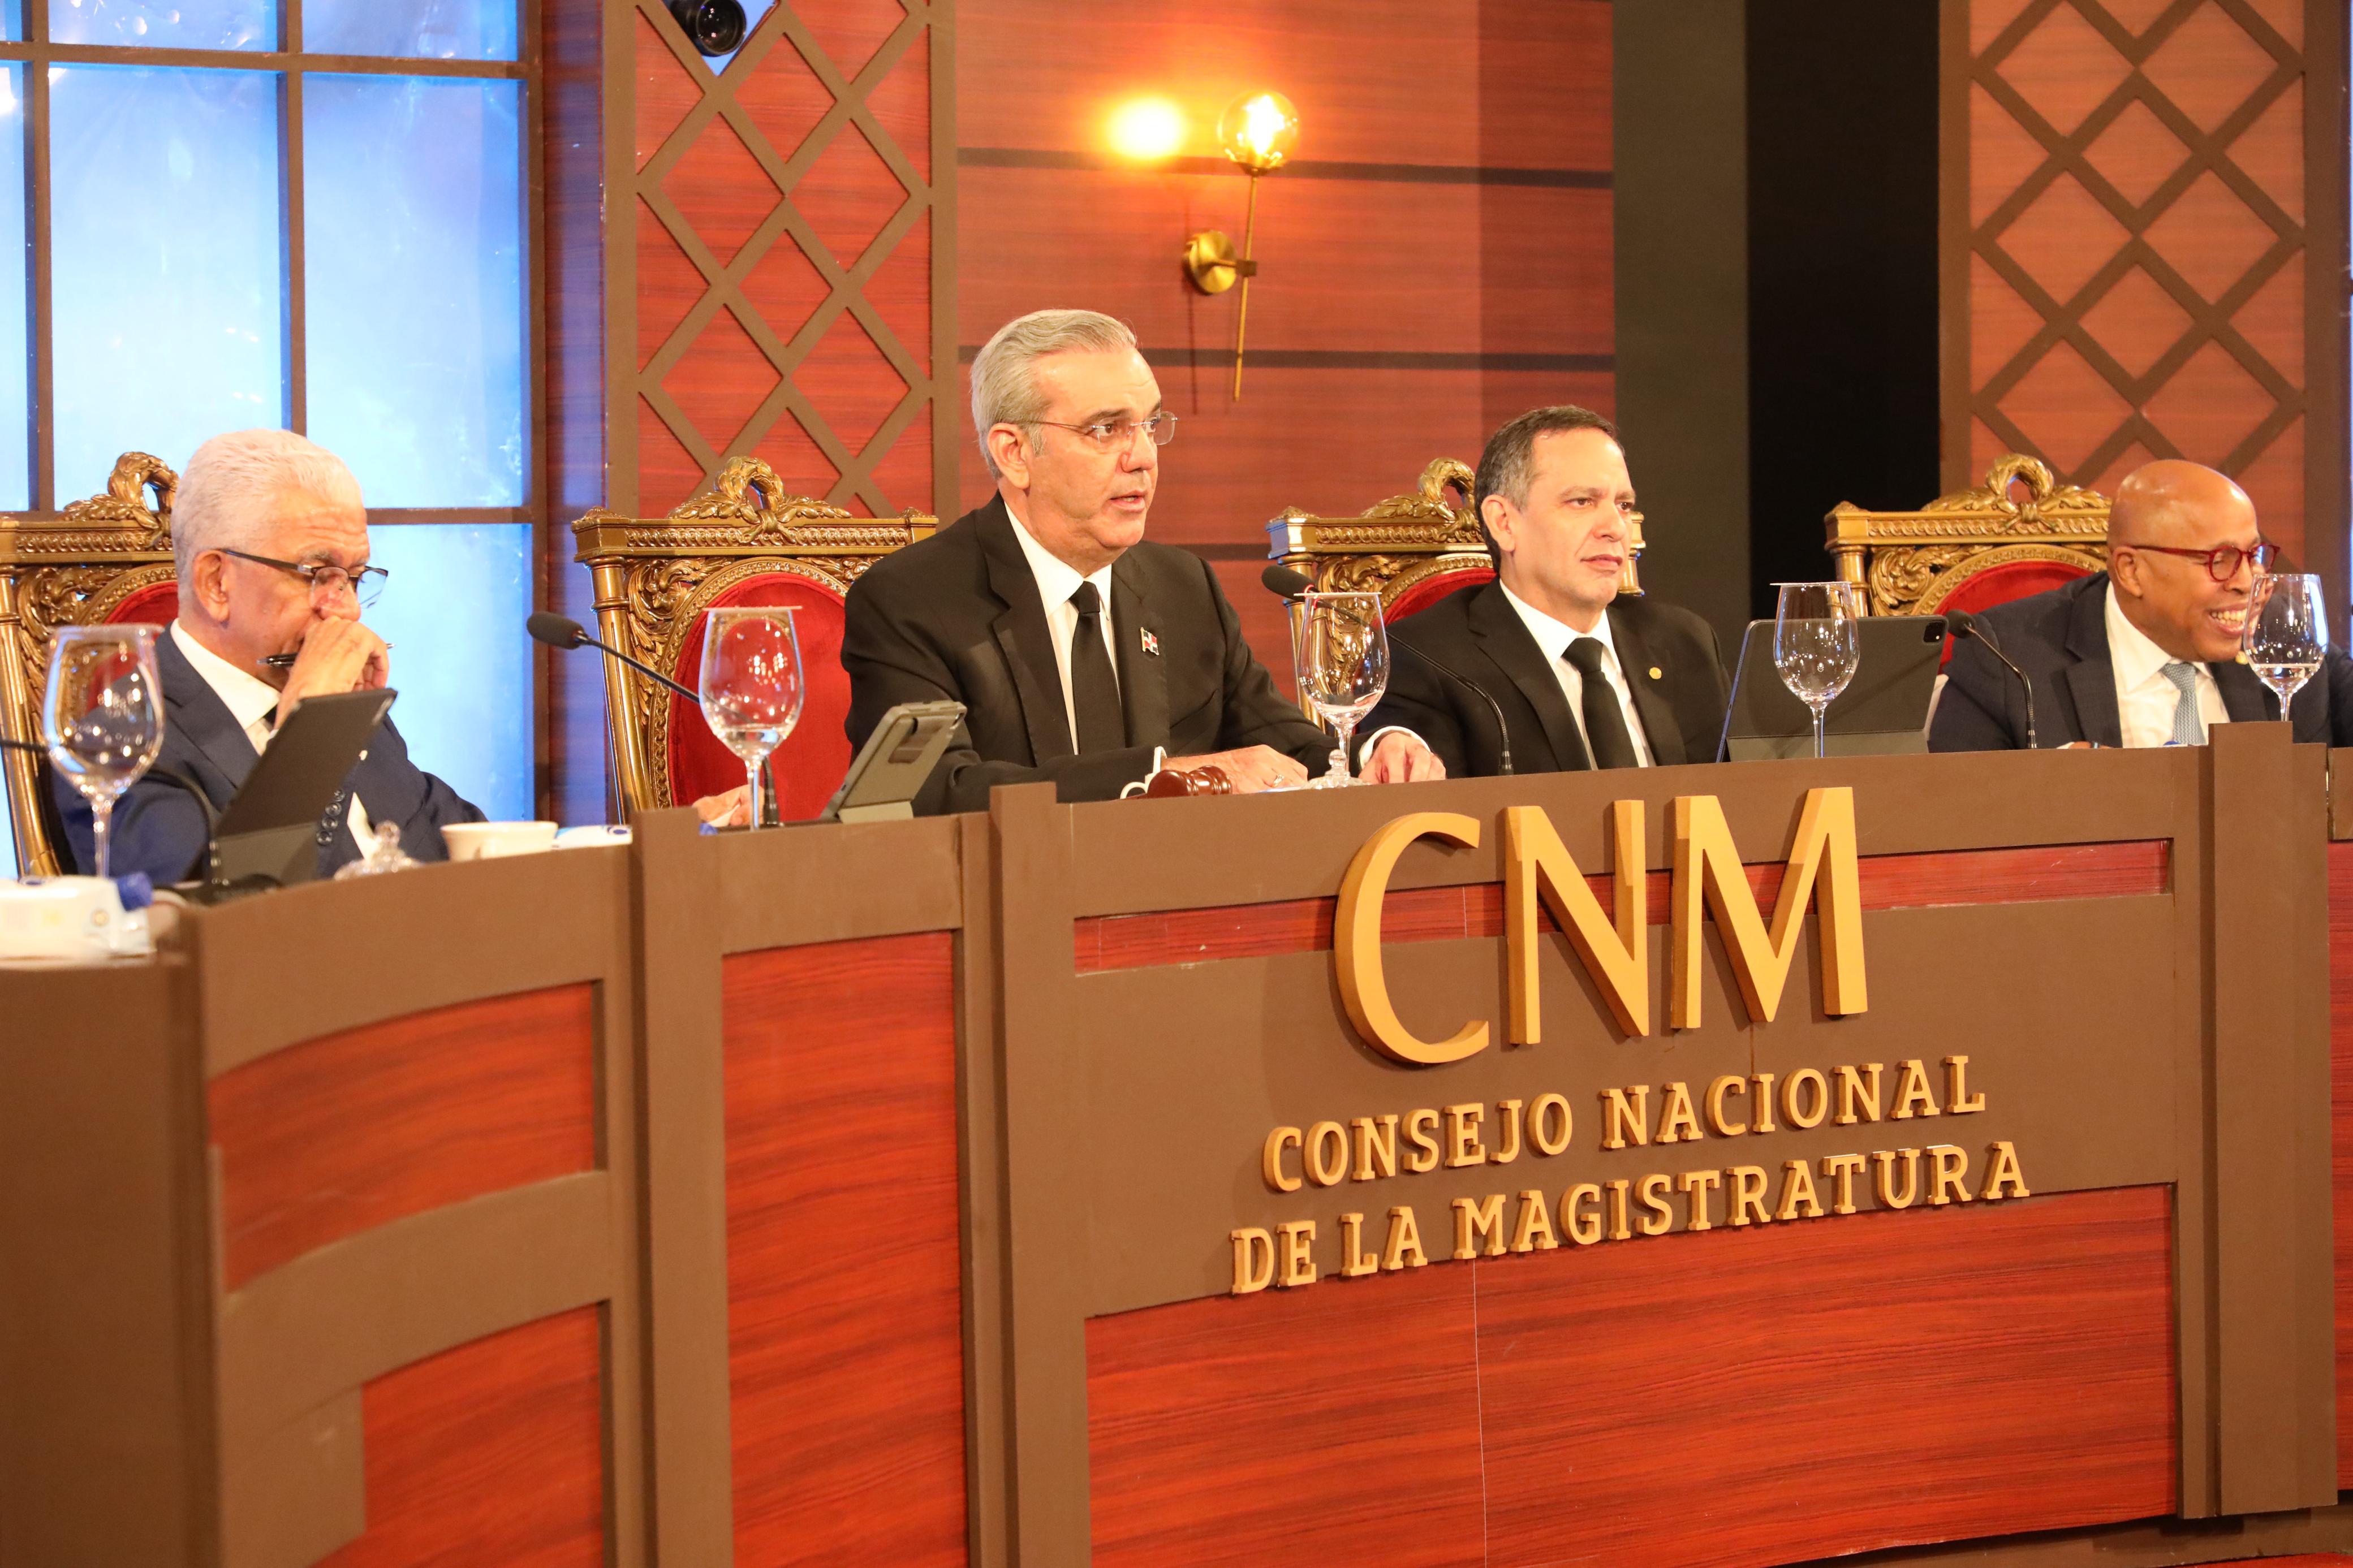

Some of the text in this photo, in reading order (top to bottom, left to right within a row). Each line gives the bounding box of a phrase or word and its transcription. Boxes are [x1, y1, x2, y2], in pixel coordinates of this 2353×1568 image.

[1335, 787, 1868, 1064] CNM
[1263, 1055, 1986, 1191] CONSEJO NACIONAL
[1231, 1141, 2030, 1294] DE LA MAGISTRATURA
